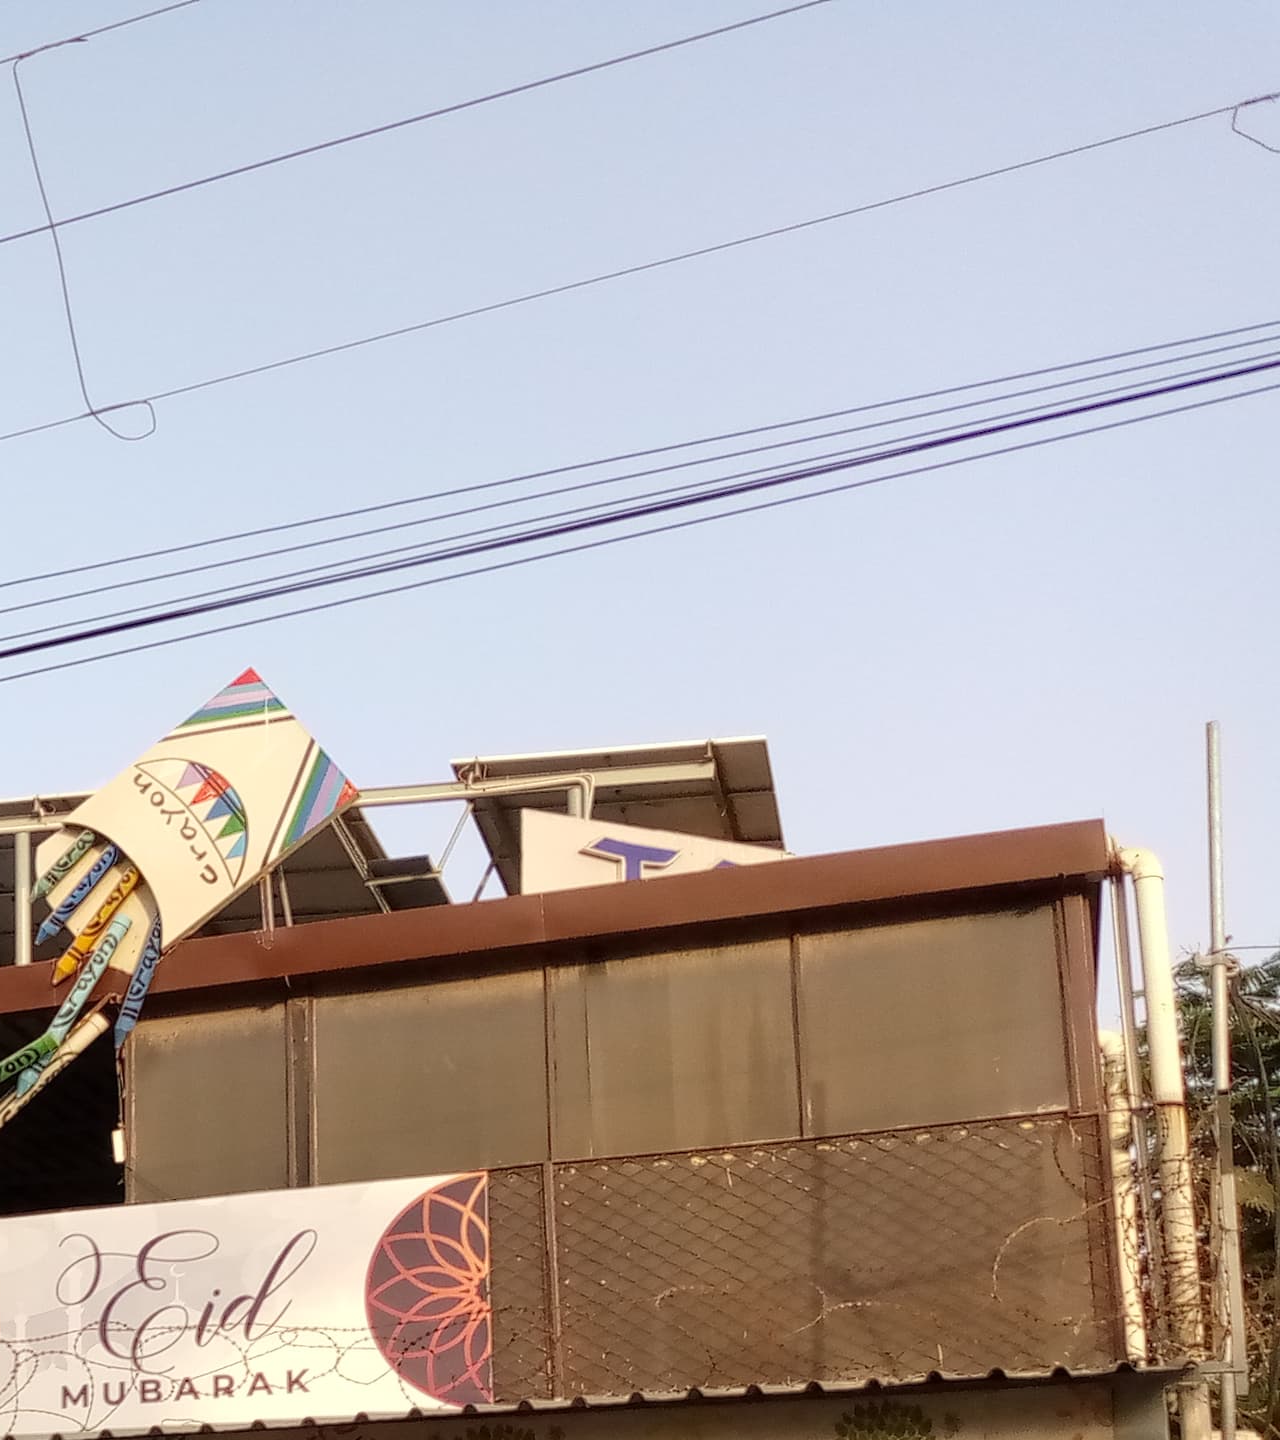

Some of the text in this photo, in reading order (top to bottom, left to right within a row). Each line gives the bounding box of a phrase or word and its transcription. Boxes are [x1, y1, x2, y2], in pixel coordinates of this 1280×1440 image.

[133, 772, 219, 885] crayon
[56, 1228, 318, 1375] Eid
[60, 1368, 312, 1409] MUBARAK
